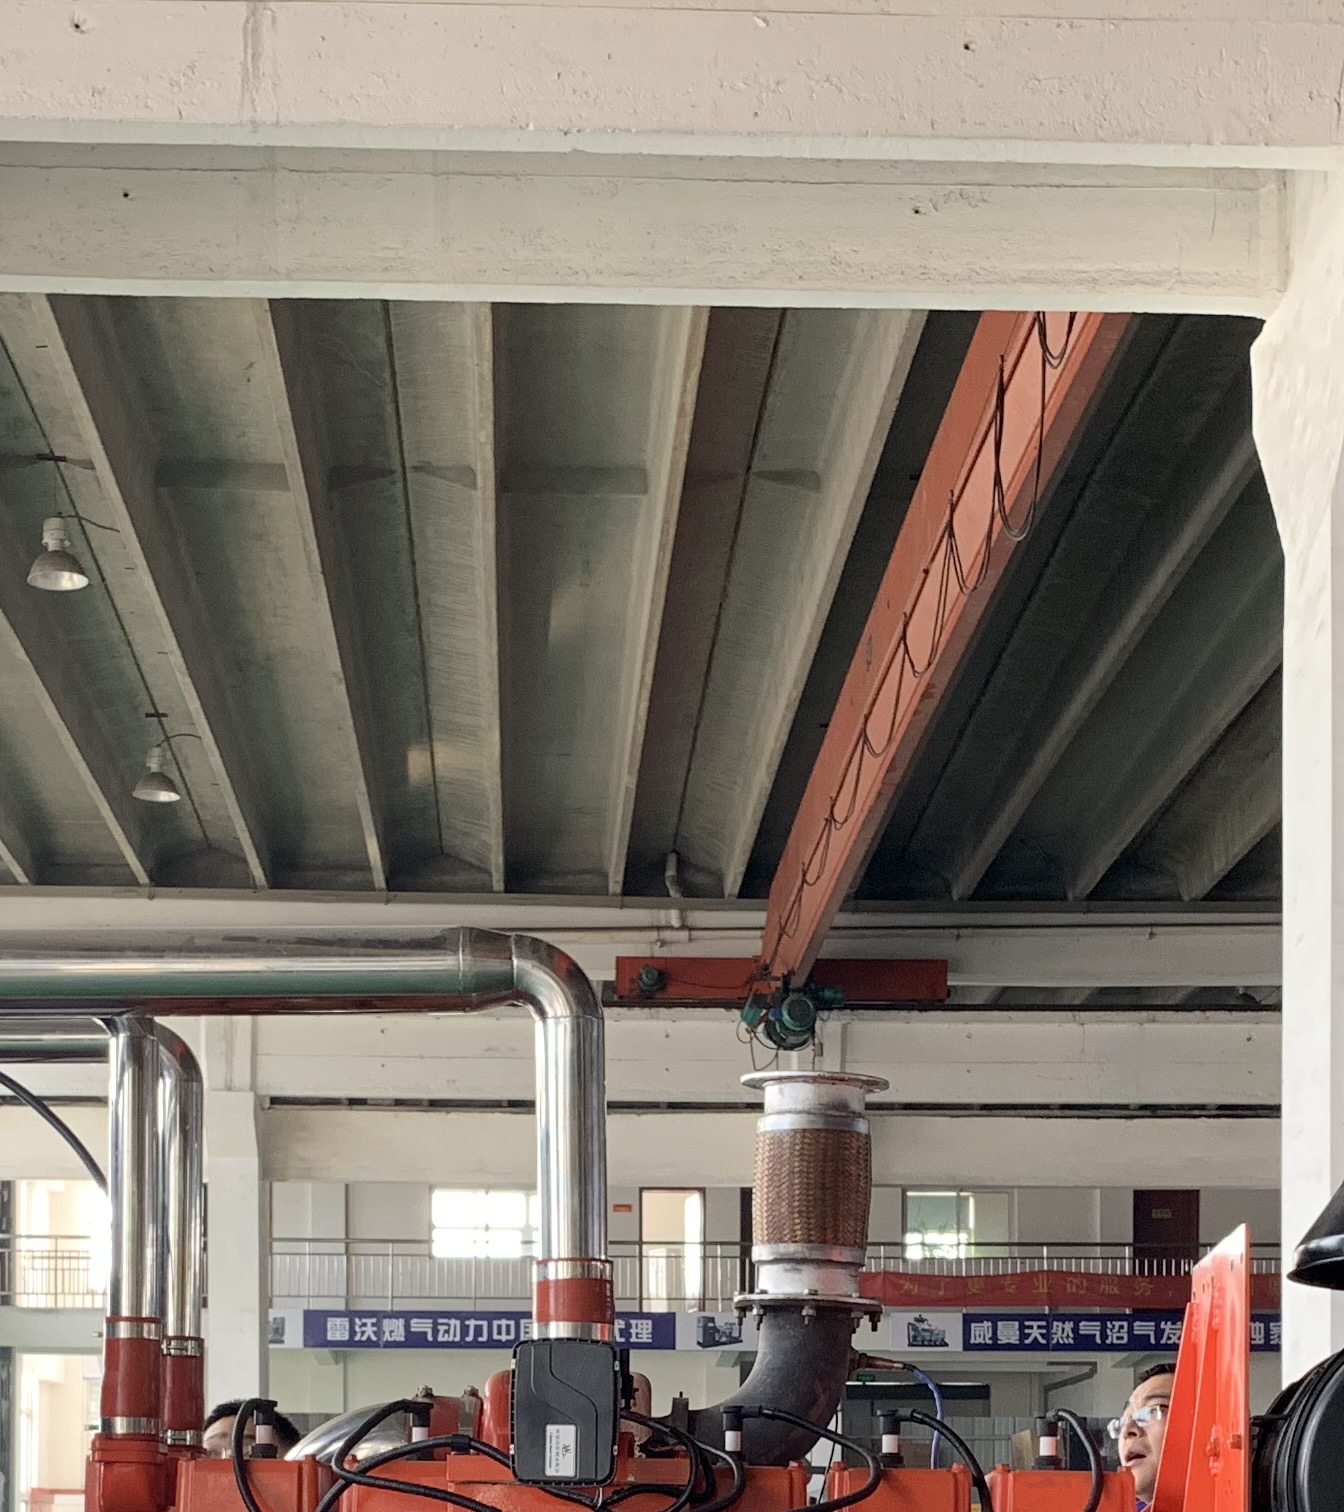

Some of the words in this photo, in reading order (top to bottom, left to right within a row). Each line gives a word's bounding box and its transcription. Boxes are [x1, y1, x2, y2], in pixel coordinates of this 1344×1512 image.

[326, 1316, 653, 1343] 雷沃燃气动力中国理
[969, 1320, 1281, 1345] 威曼天然气沼气发独
